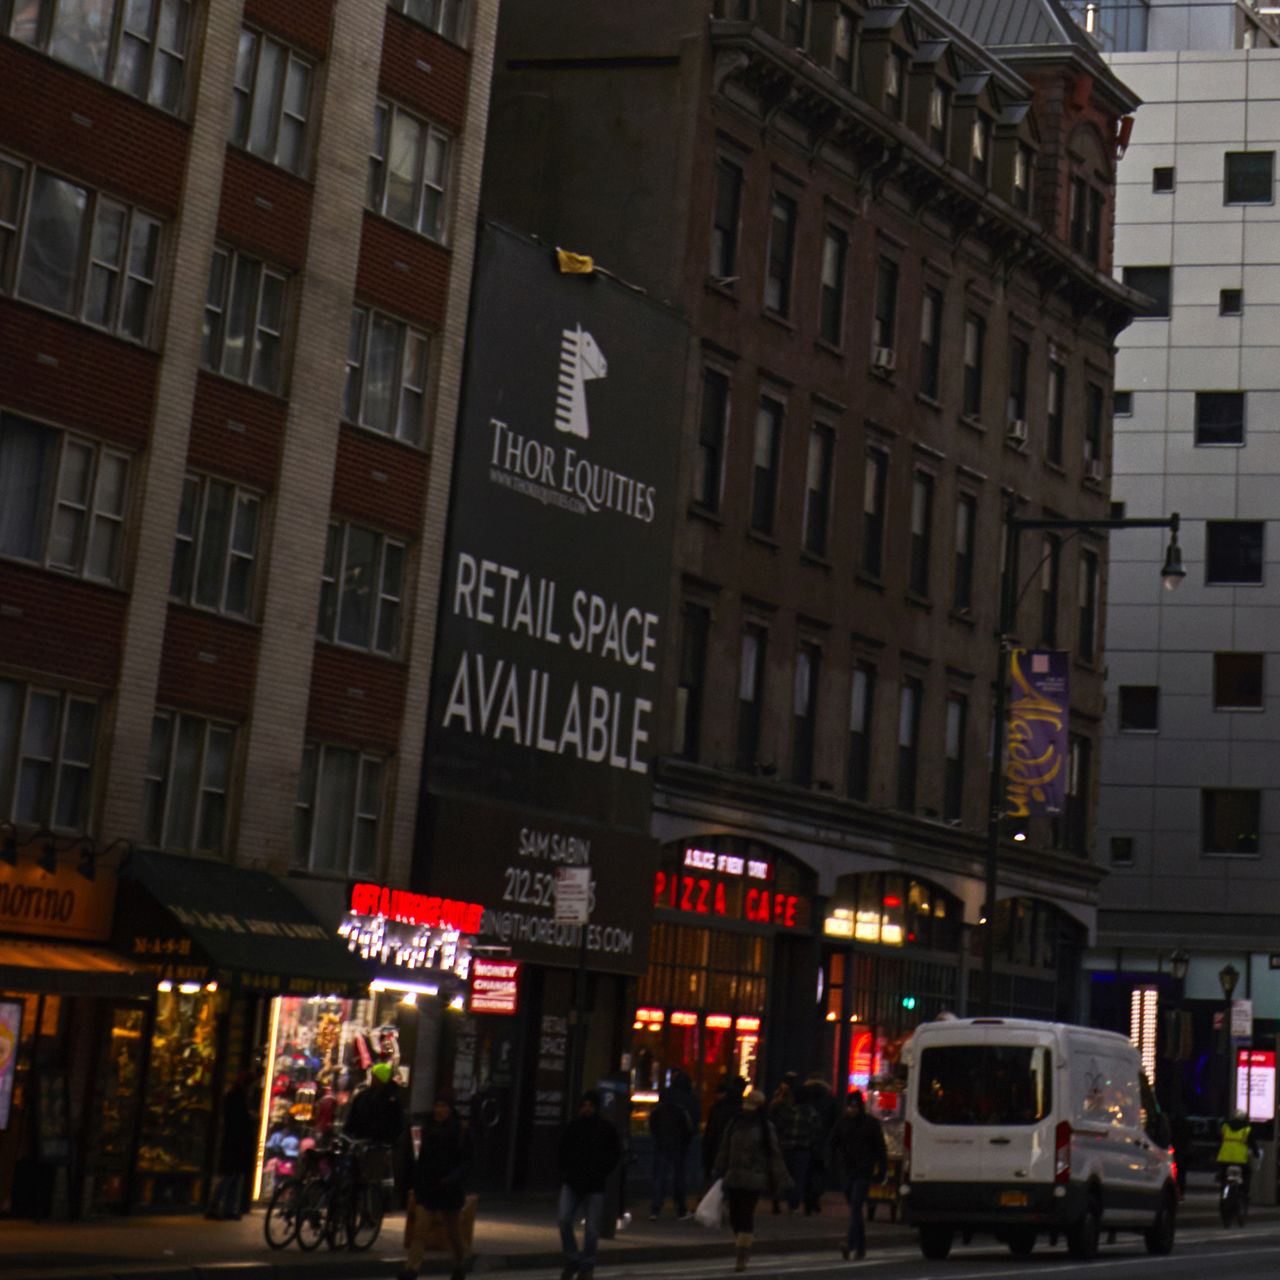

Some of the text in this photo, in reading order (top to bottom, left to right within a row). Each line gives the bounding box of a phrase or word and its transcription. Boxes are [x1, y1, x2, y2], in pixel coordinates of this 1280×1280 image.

[490, 417, 656, 523] THOR EQUITIES
[454, 552, 659, 672] RETAIL SPACE
[442, 650, 653, 775] AVAILABLE
[653, 870, 726, 916] PIZZA
